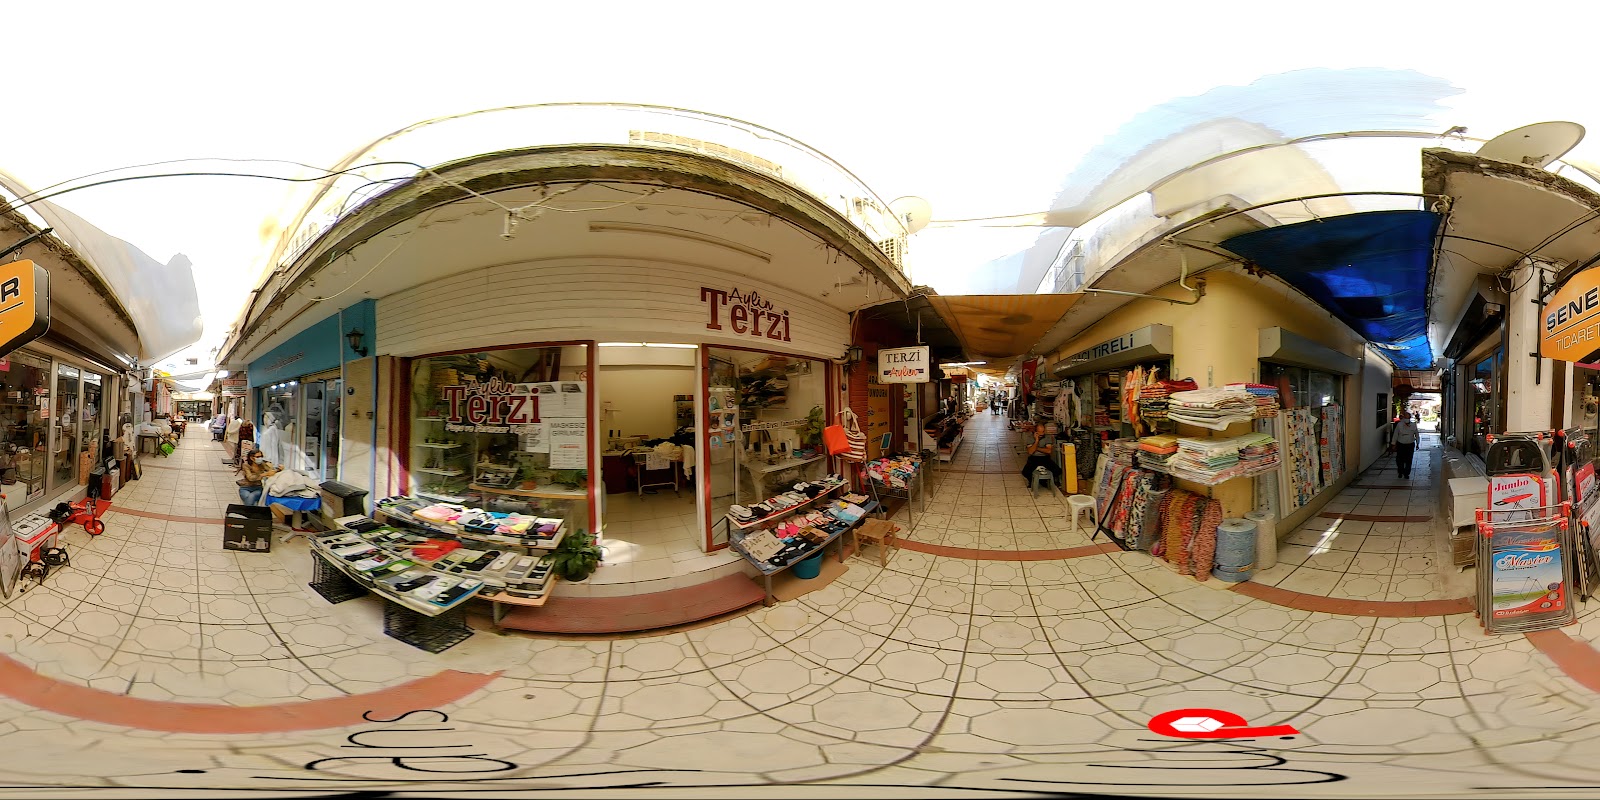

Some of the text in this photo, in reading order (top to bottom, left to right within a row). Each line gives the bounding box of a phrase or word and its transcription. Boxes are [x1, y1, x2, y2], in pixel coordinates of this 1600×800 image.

[728, 287, 774, 311] Aylin
[701, 287, 791, 342] Terzi
[886, 350, 922, 364] TERZİ
[888, 365, 919, 380] Aylin
[466, 376, 516, 399] Aylin
[443, 386, 542, 424] Terzi
[1494, 478, 1529, 492] Jumbo
[1496, 553, 1553, 569] Master
